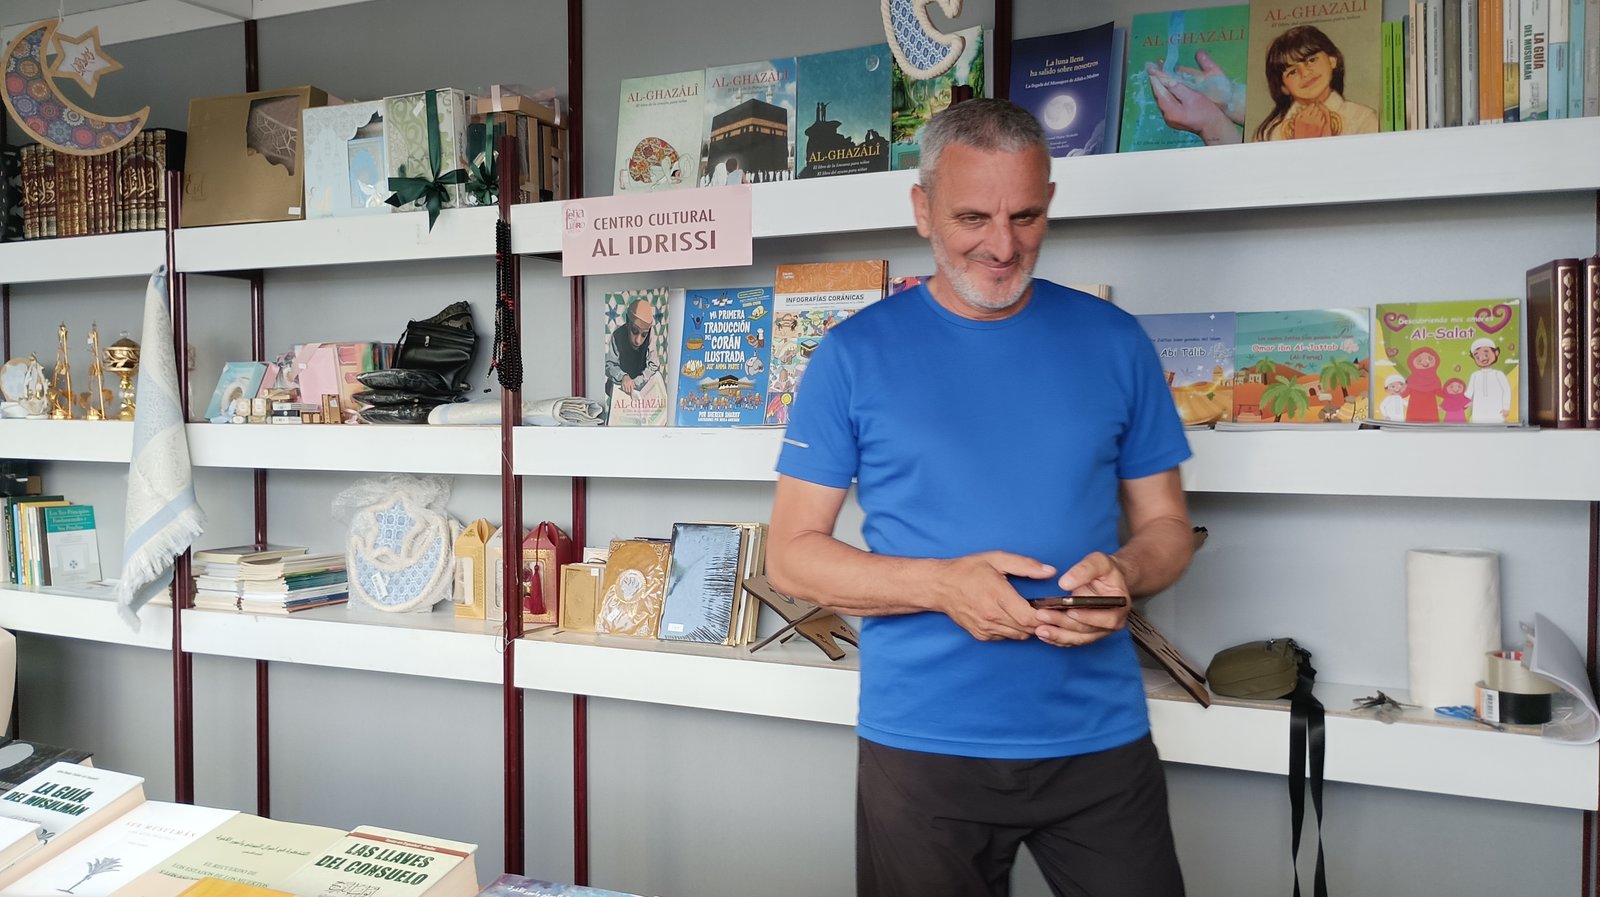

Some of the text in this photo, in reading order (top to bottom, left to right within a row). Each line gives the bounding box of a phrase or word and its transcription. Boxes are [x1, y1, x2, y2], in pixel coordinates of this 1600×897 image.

[1533, 32, 1545, 43] LA
[1523, 24, 1533, 81] DEL MUSULMÁN
[1533, 46, 1545, 70] GUÍA
[1030, 61, 1099, 77] ha salido sobre nosotros
[1055, 58, 1069, 66] luna
[1069, 56, 1084, 64] llena
[593, 208, 716, 231] CENTRO CULTURAL
[591, 230, 716, 258] AL IDRISSI
[785, 293, 865, 303] INFOGRAFÍAS CORÁNICAS
[718, 309, 745, 320] PRIMERA
[703, 320, 751, 334] TRADUCCIÓN
[1410, 326, 1476, 341] Al-Salat
[711, 333, 742, 350] CORÁN
[1251, 344, 1274, 353] Omar
[1277, 343, 1292, 353] ibn
[704, 350, 746, 363] ILUSTRADA
[31, 782, 95, 803] LA GUÍA
[3, 791, 91, 817] DEL MUSULMÁN
[345, 843, 435, 868] LAS LLAVES
[314, 855, 429, 885] DEL CONSUELO
